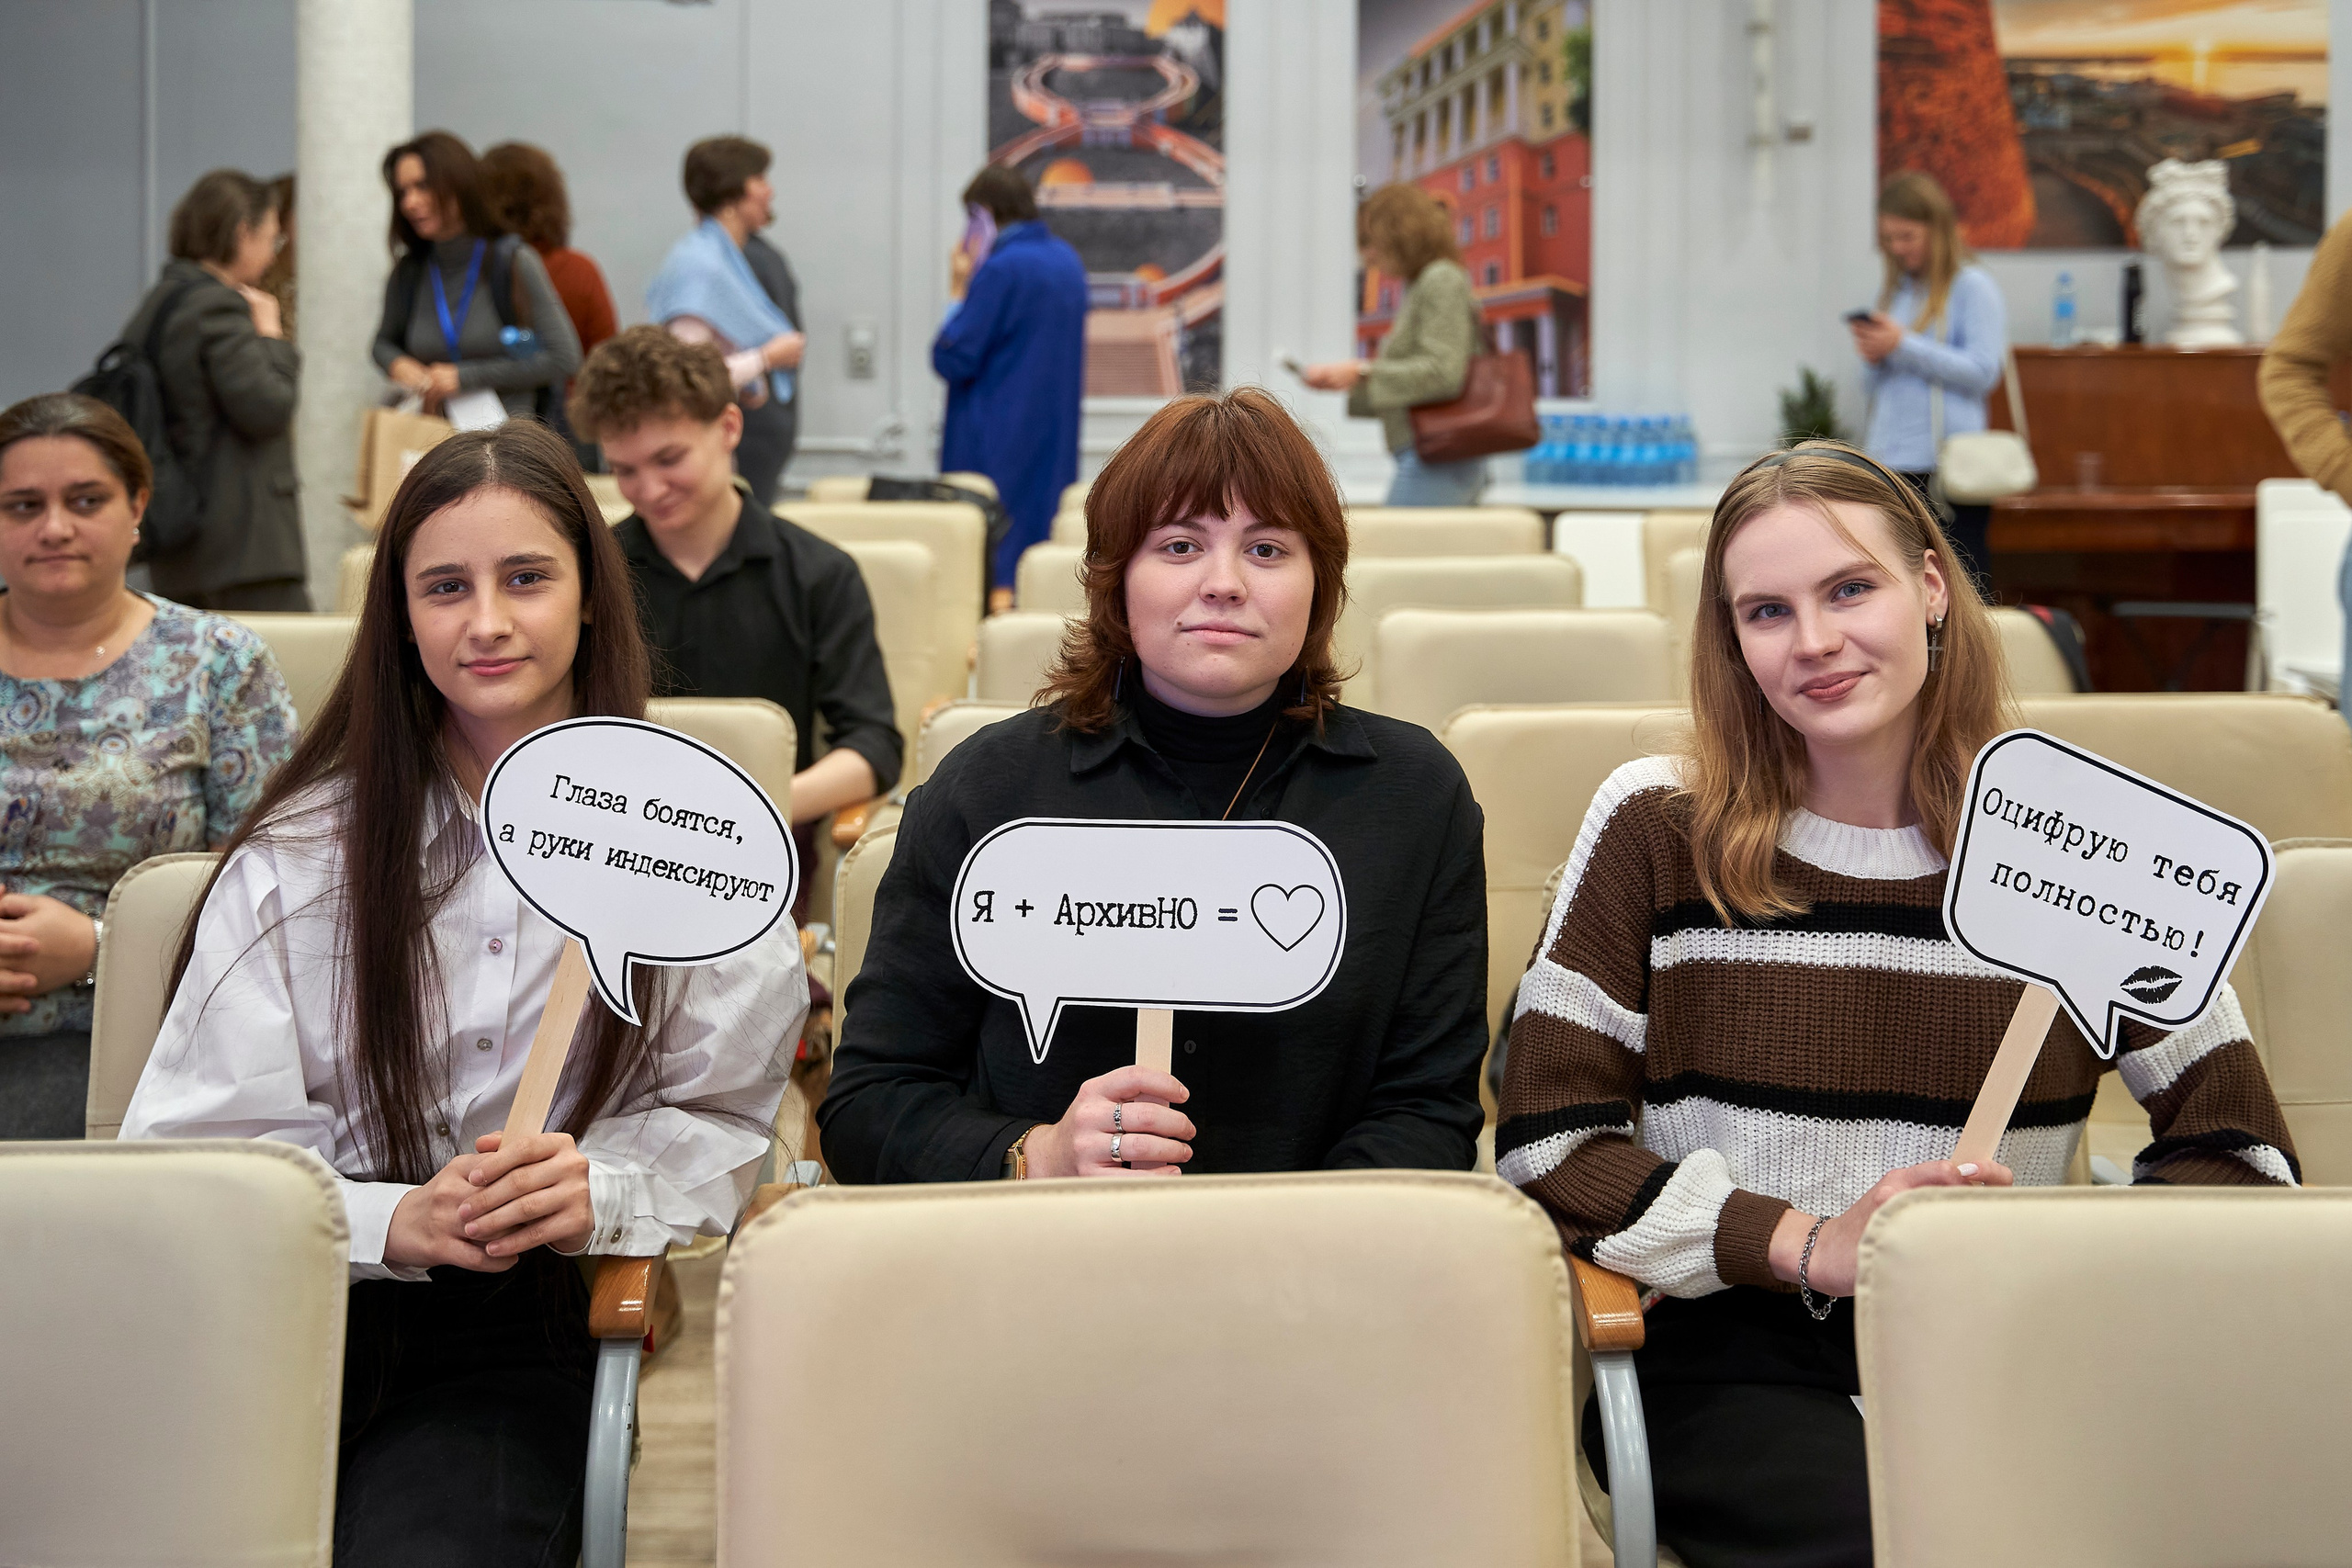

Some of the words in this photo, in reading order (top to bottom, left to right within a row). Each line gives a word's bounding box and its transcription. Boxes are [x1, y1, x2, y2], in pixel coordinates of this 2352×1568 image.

[550, 774, 627, 814] Глаза
[643, 798, 742, 844] боятся,
[1983, 788, 2128, 862] Оцифрую
[2154, 855, 2242, 906] тебя
[499, 824, 514, 842] а
[527, 830, 594, 861] руки
[605, 848, 774, 902] индексируют
[972, 891, 995, 922] Я
[1054, 894, 1197, 936] АрхивНО
[1990, 863, 2203, 957] полностью!
